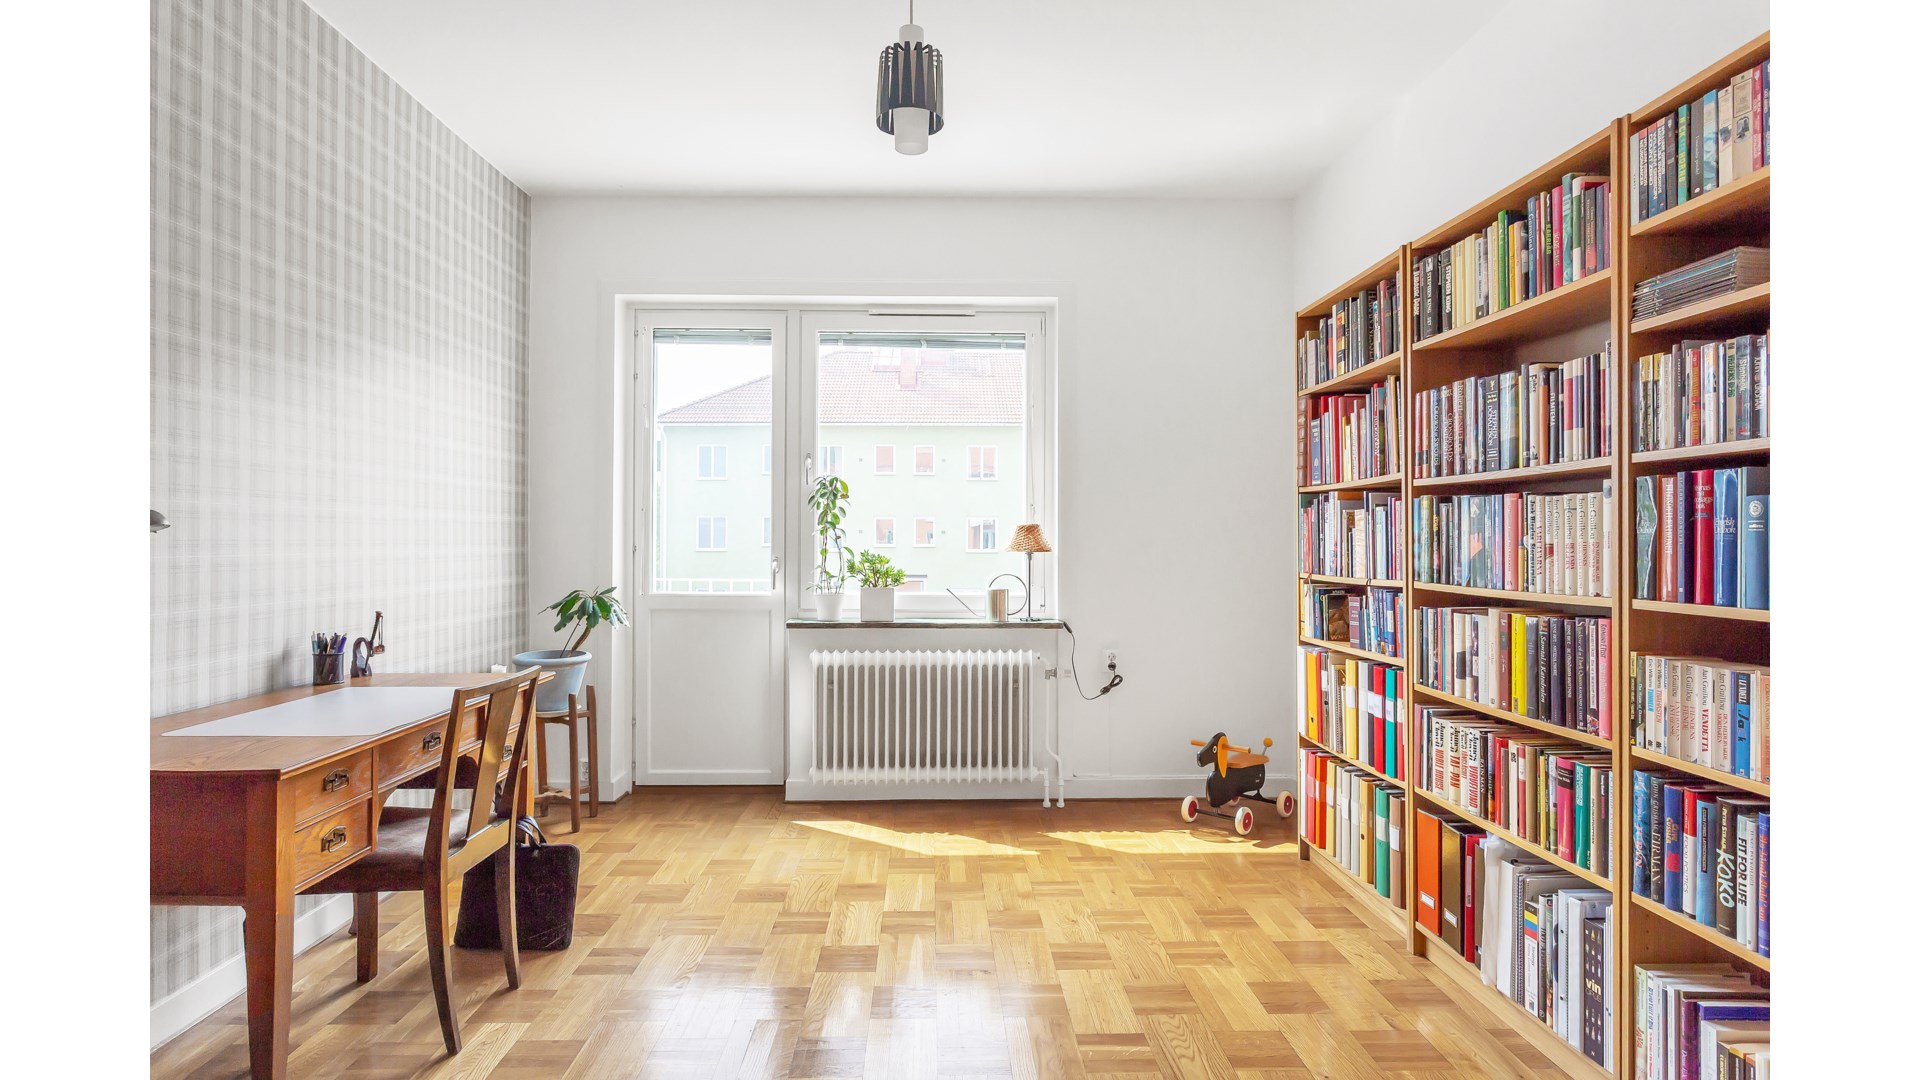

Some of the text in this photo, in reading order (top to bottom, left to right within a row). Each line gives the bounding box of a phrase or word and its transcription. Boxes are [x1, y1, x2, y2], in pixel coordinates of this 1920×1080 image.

[1589, 495, 1597, 509] Jan
[1565, 510, 1573, 540] Guillou
[1589, 509, 1597, 540] Guillou
[1435, 748, 1444, 791] NOBLE HOUSE
[1450, 755, 1460, 789] TAI-PAN
[1652, 831, 1661, 883] FIRMAN
[1738, 837, 1747, 906] FIT FOR LIFE
[1716, 848, 1735, 908] KOKO
[1585, 977, 1602, 996] vin
